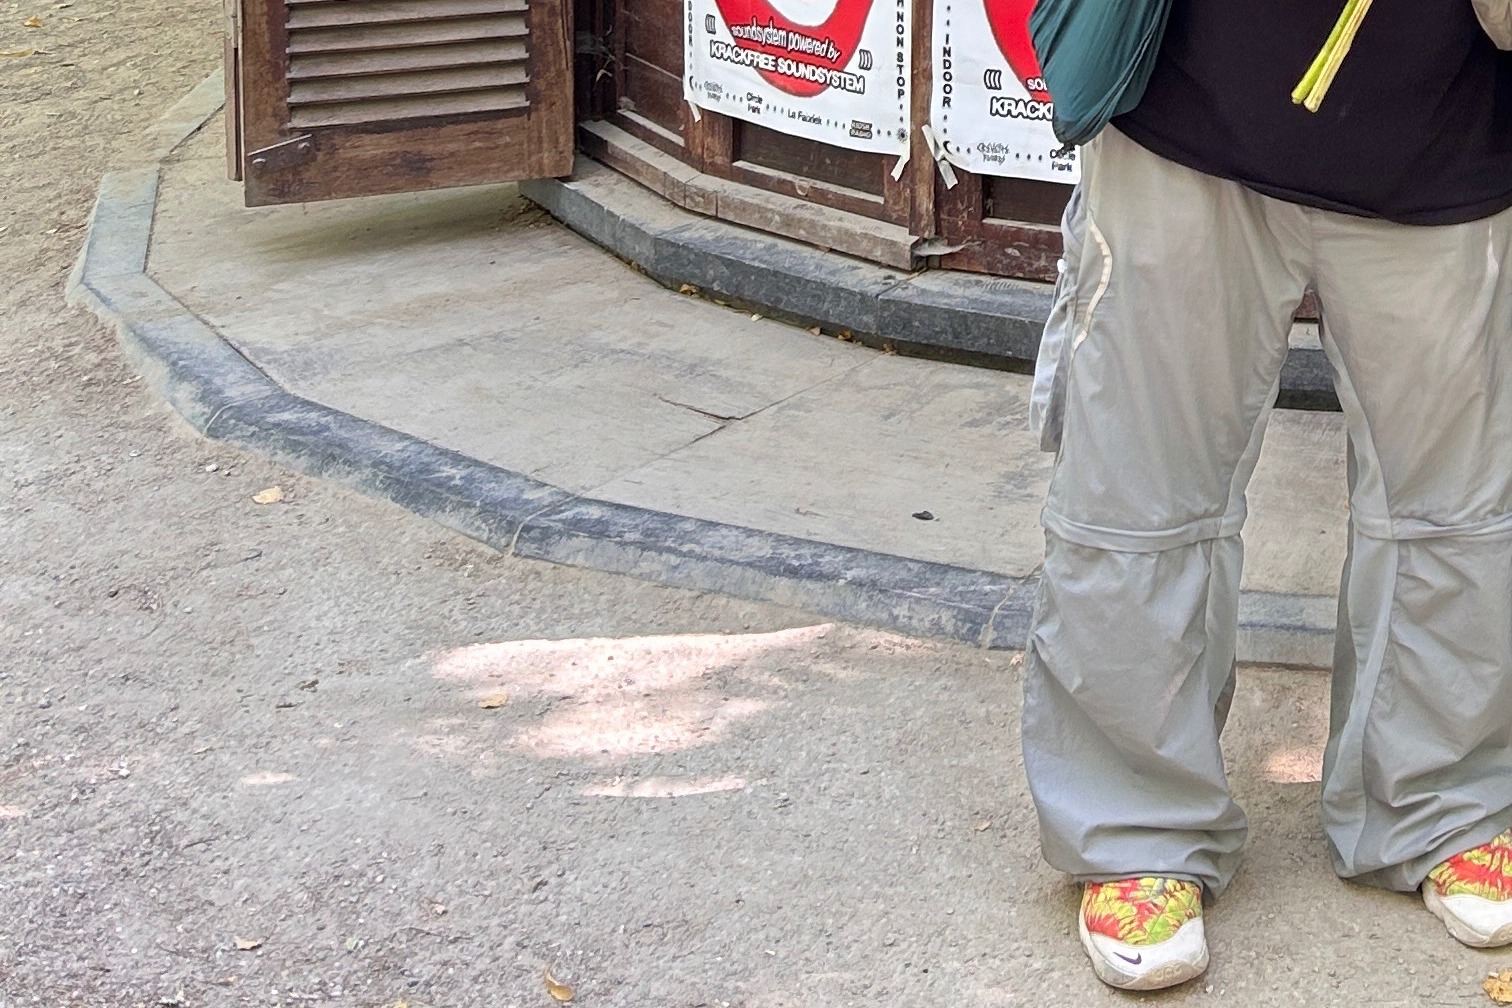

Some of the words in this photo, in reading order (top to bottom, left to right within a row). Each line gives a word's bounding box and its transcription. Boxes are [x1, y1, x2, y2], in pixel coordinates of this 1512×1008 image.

[730, 16, 787, 47] soundsystem
[787, 30, 828, 59] powered
[828, 37, 842, 62] by
[896, 11, 905, 47] NON
[710, 40, 778, 72] KRACKFREE
[777, 56, 866, 94] SOUNDSYSTEM
[897, 52, 905, 99] STOP
[942, 34, 953, 109] INDOOR
